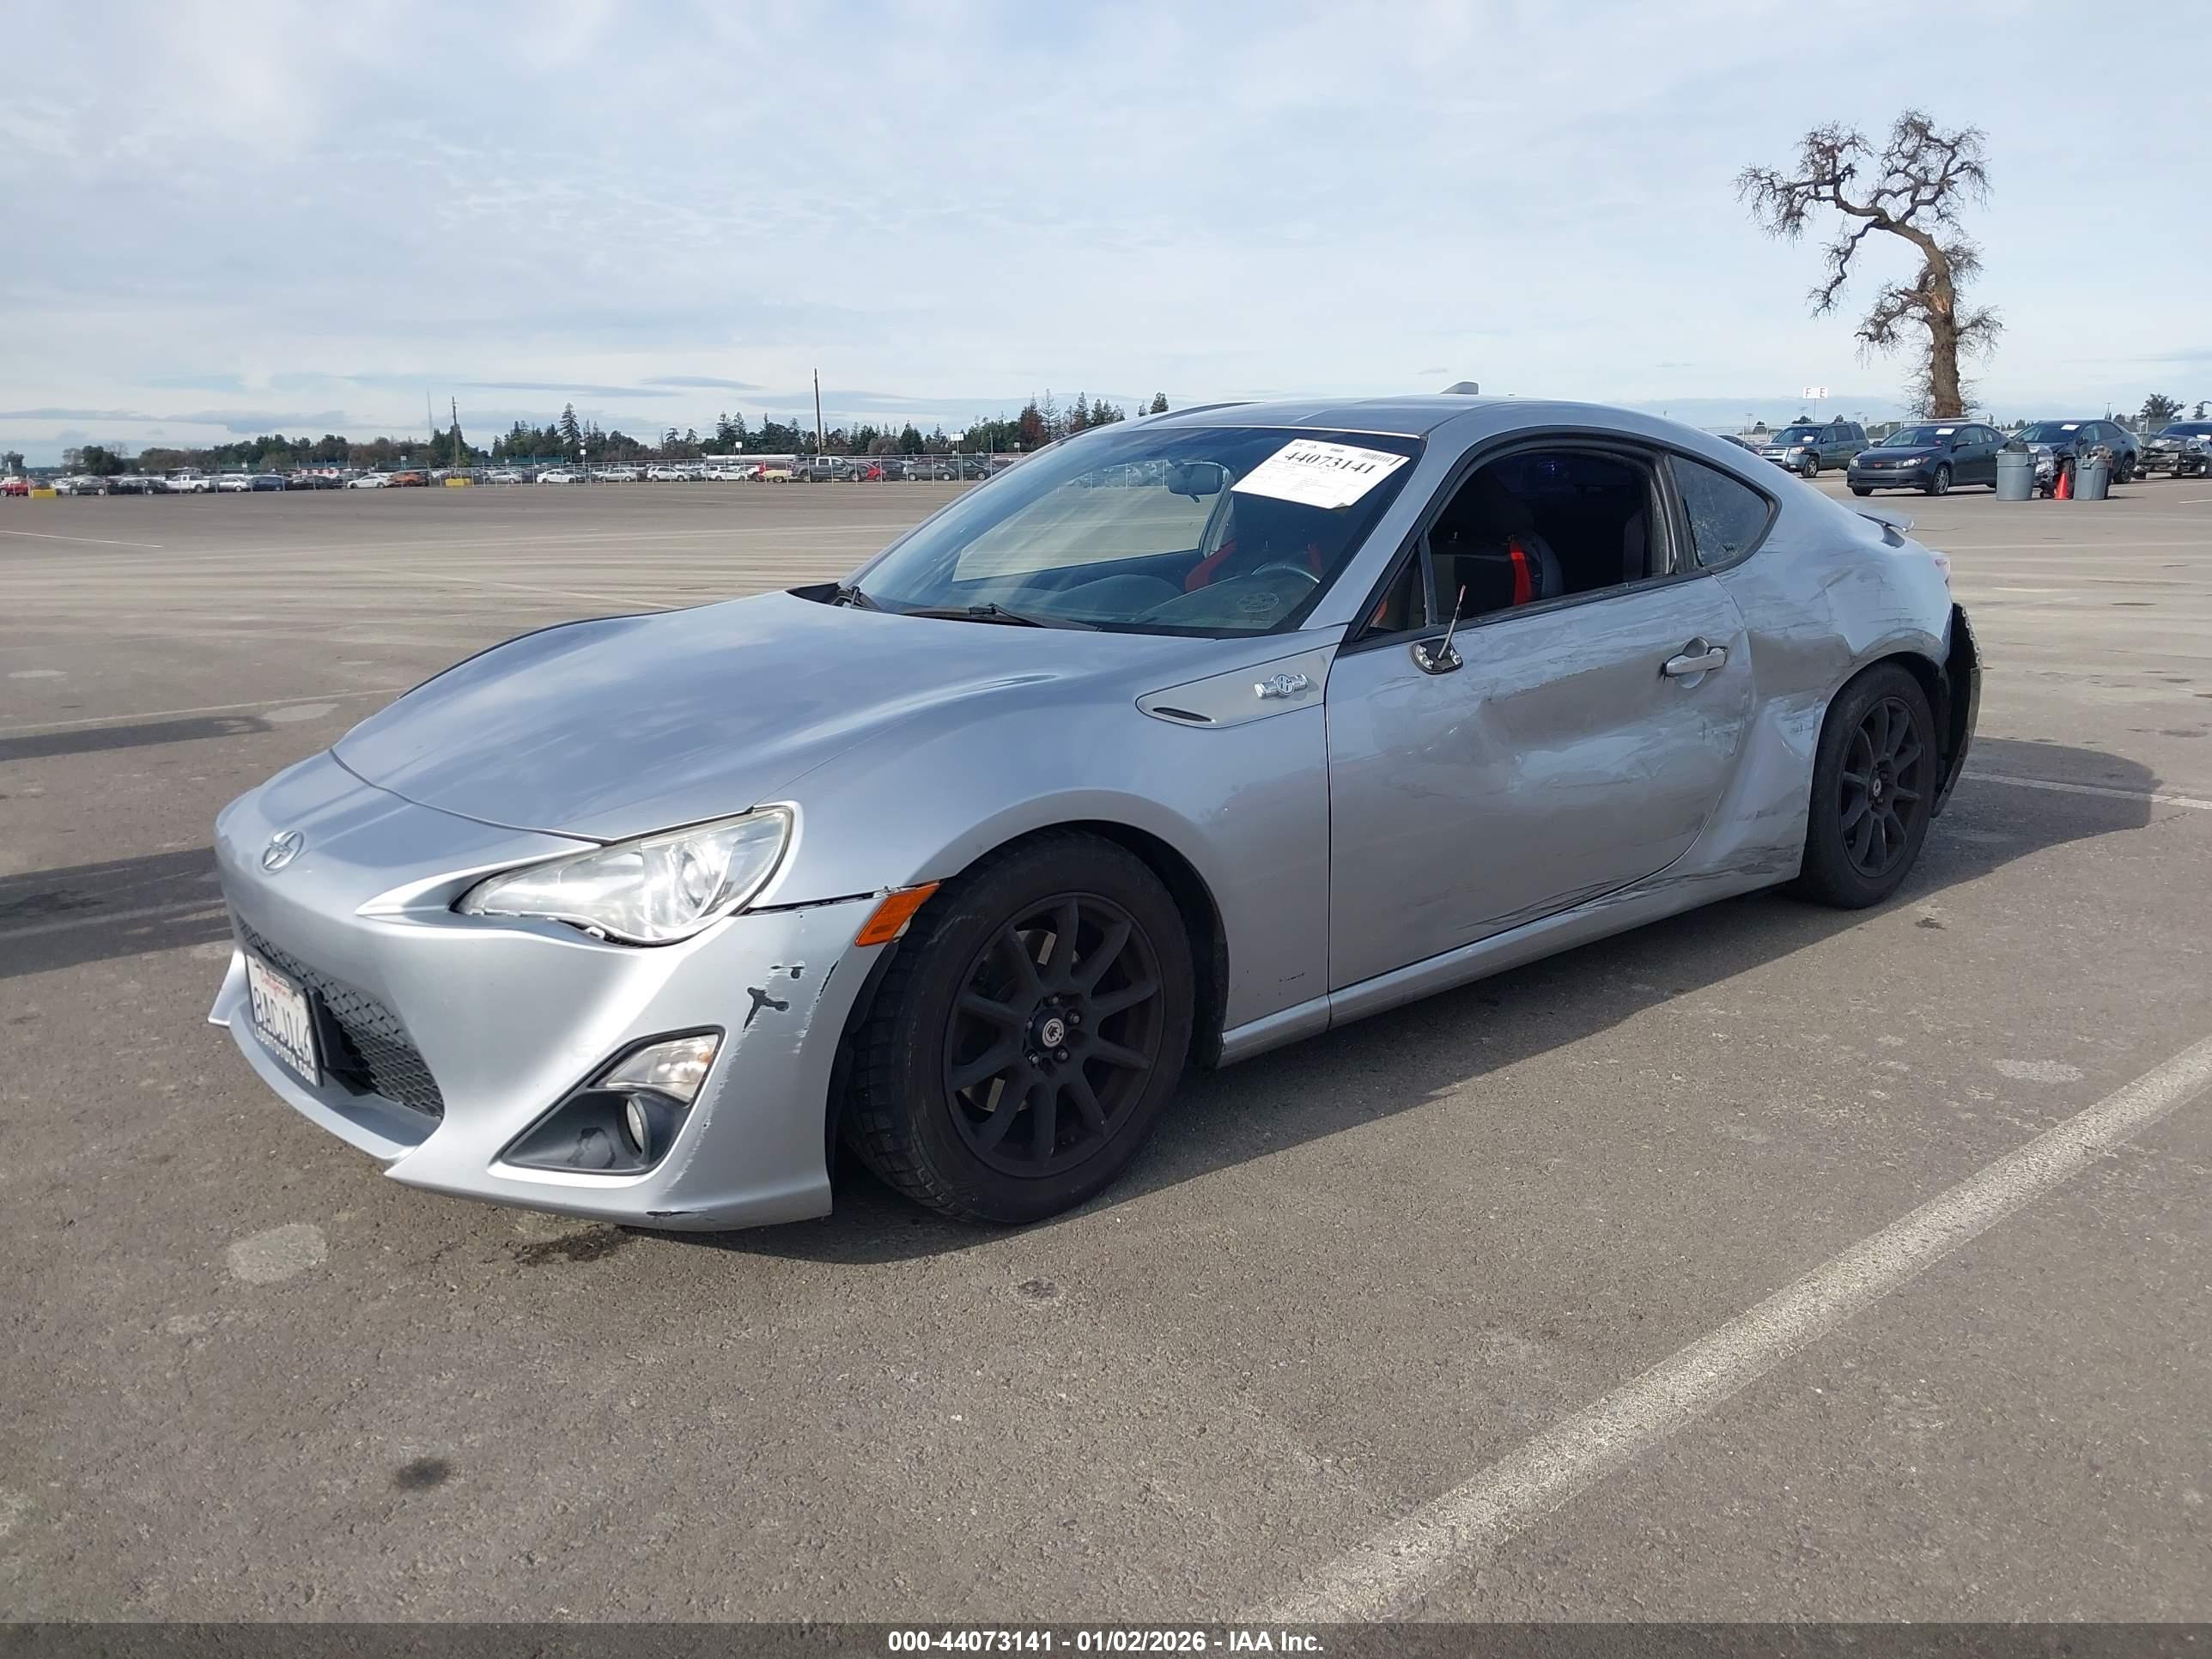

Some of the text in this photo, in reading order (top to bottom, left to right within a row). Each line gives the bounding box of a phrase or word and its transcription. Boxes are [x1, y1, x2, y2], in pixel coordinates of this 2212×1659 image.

[1806, 387, 1826, 398] F E
[1285, 451, 1376, 474] 44073141
